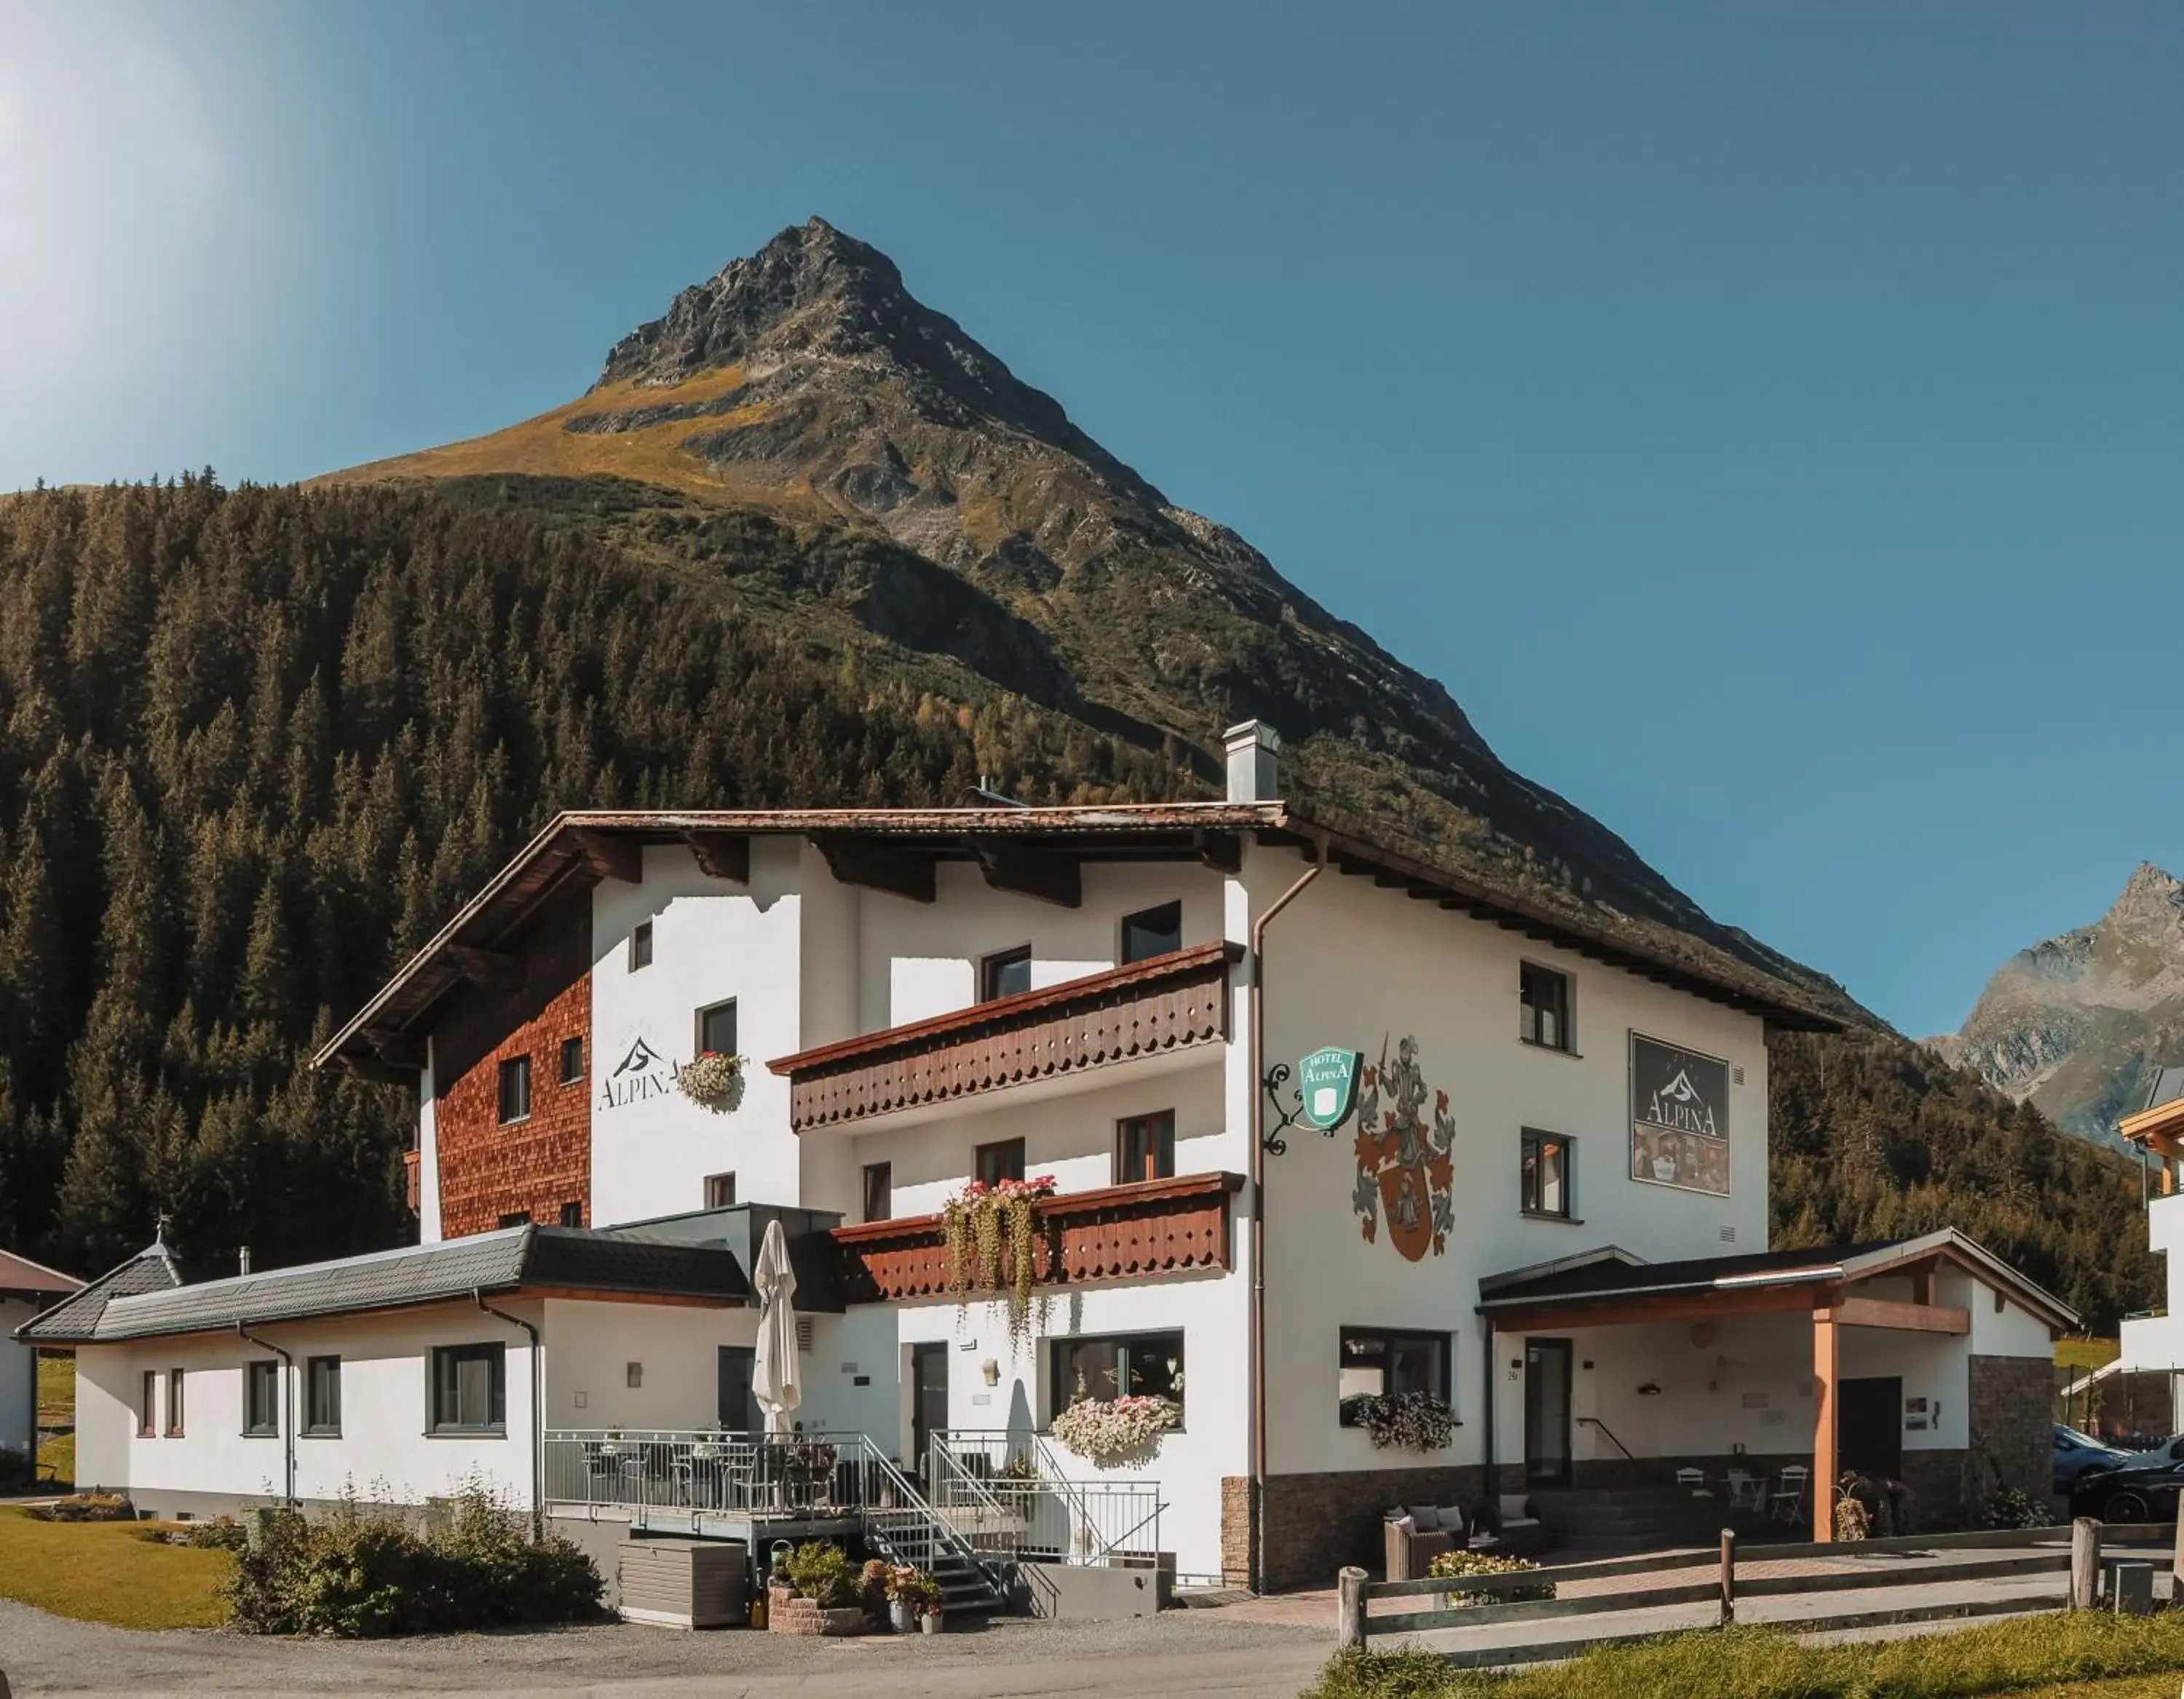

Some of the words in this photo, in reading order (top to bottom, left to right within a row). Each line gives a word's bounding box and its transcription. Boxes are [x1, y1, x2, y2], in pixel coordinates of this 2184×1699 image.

[1311, 1053, 1342, 1067] HOTEL
[1305, 1065, 1348, 1082] ALPINA
[1647, 1090, 1717, 1136] ALPINA
